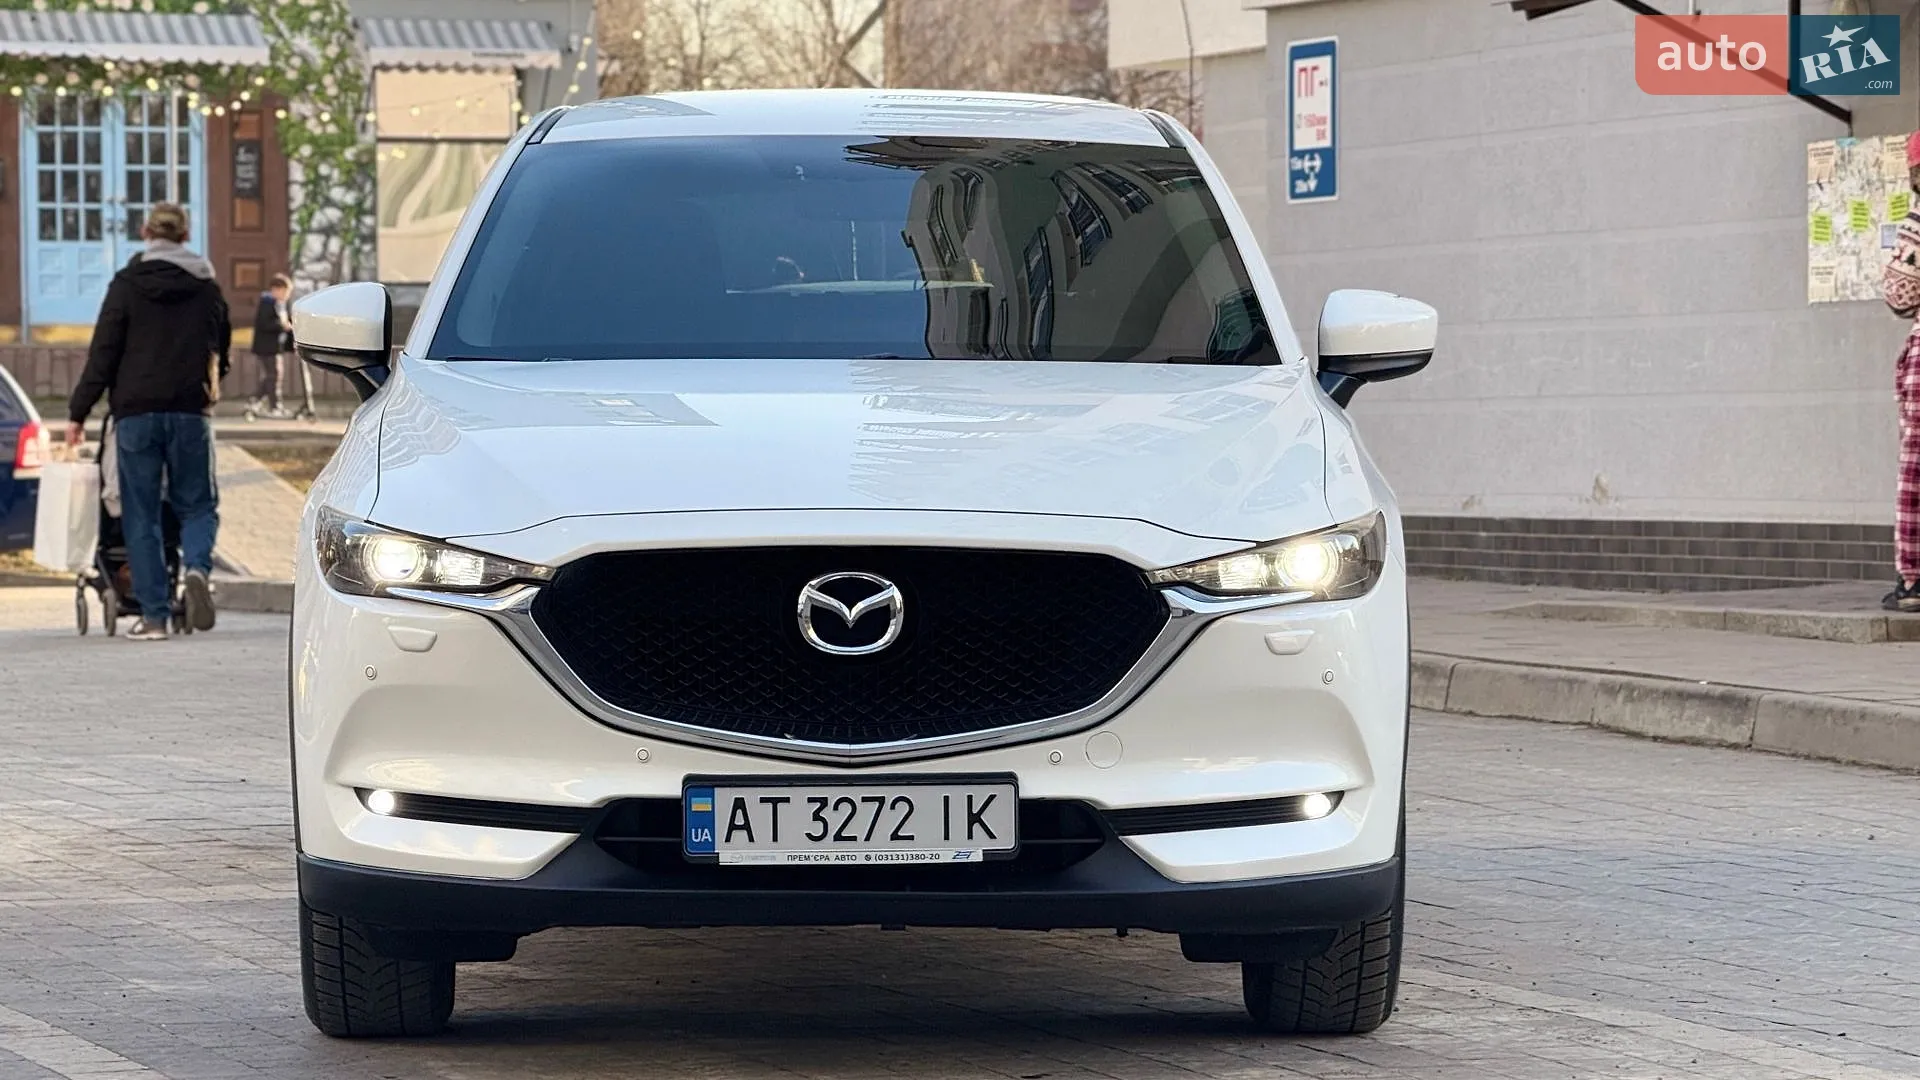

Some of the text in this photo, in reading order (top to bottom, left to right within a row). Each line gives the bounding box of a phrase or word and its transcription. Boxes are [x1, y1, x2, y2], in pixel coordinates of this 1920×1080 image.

[724, 793, 998, 843] AT 3272 IK
[691, 828, 712, 843] UA
[874, 853, 940, 862] (03131)380-20
